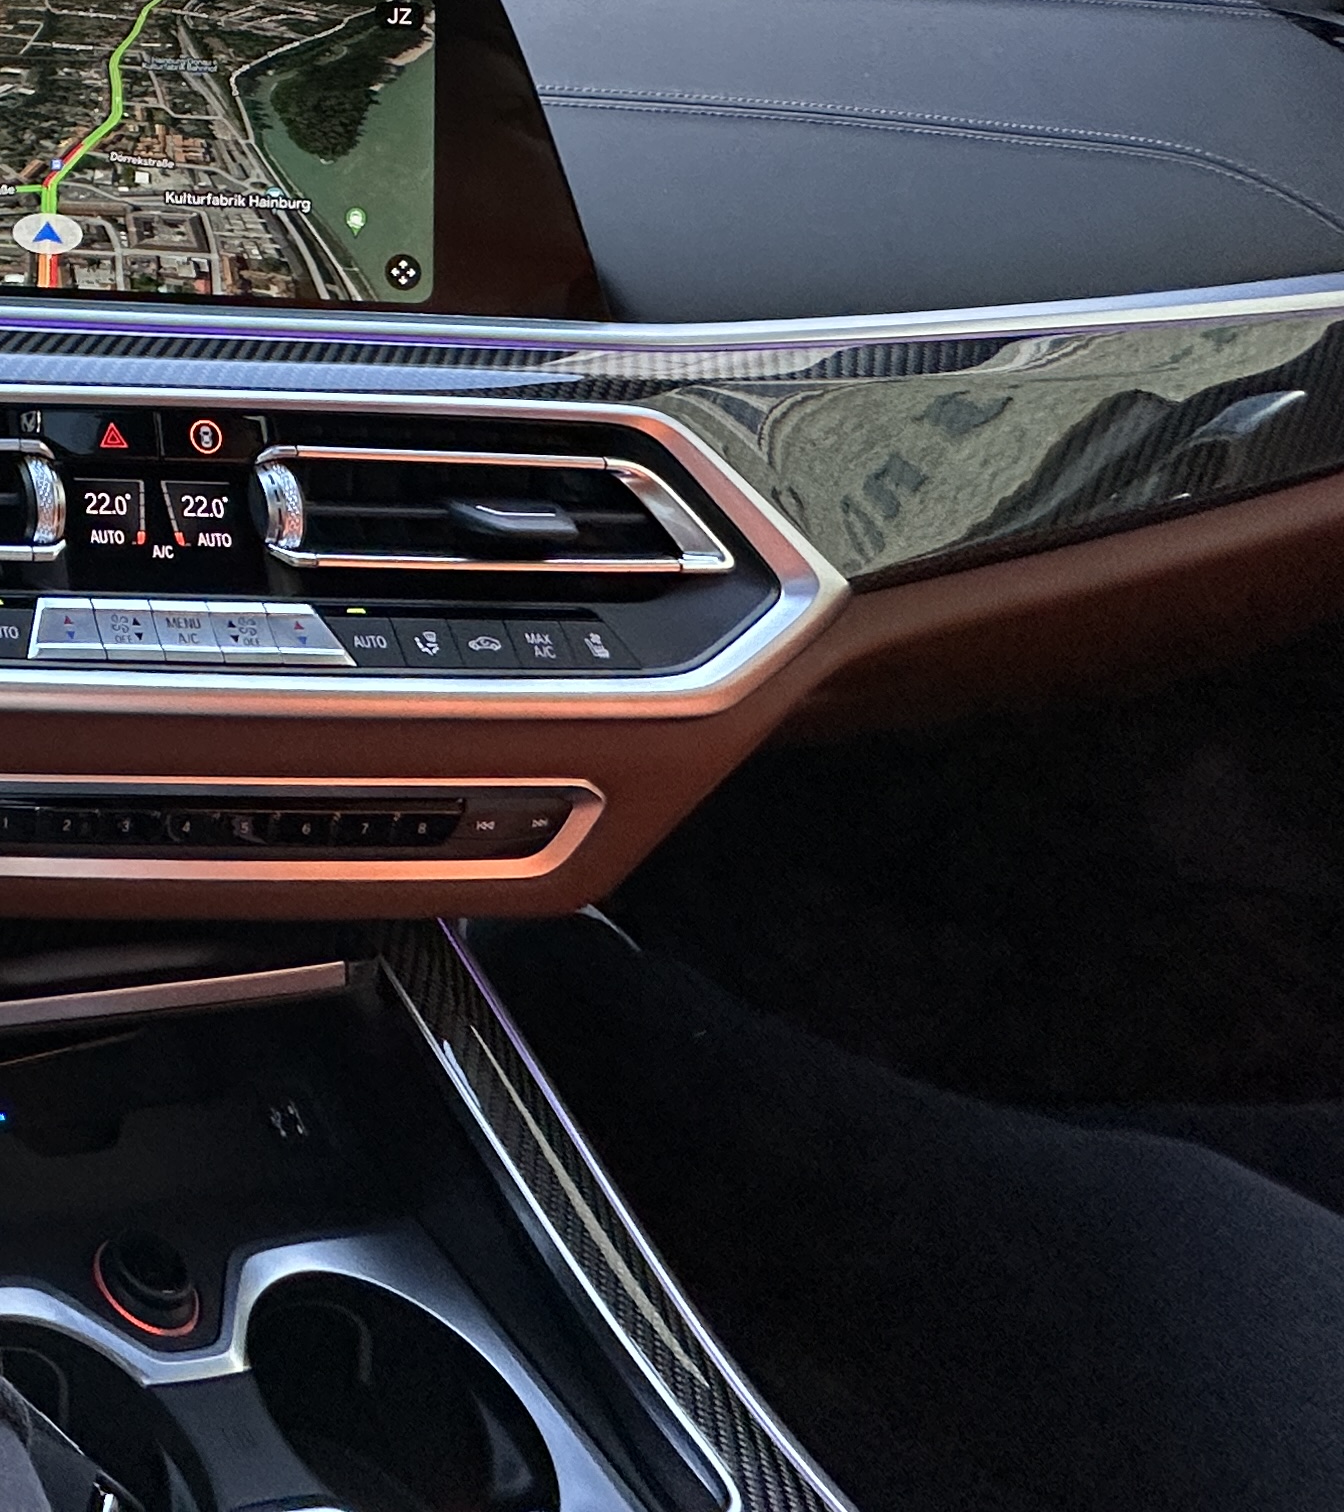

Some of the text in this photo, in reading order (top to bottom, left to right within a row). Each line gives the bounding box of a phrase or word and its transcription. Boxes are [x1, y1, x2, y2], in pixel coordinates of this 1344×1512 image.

[386, 7, 413, 25] JZ
[165, 191, 312, 213] Kulturfabrik Hainburg
[90, 529, 125, 545] AUTO
[197, 532, 232, 548] AUTO
[165, 617, 202, 630] MENU
[178, 632, 198, 645] A/C
[353, 635, 388, 649] AUTO
[525, 632, 554, 646] MAX
[3, 816, 9, 829] 1
[62, 819, 72, 832] 2
[121, 820, 130, 833] 3
[181, 821, 191, 832] 4
[240, 822, 250, 834] 5
[301, 823, 311, 835] 6
[361, 822, 370, 835] 7
[417, 822, 427, 835] 8
